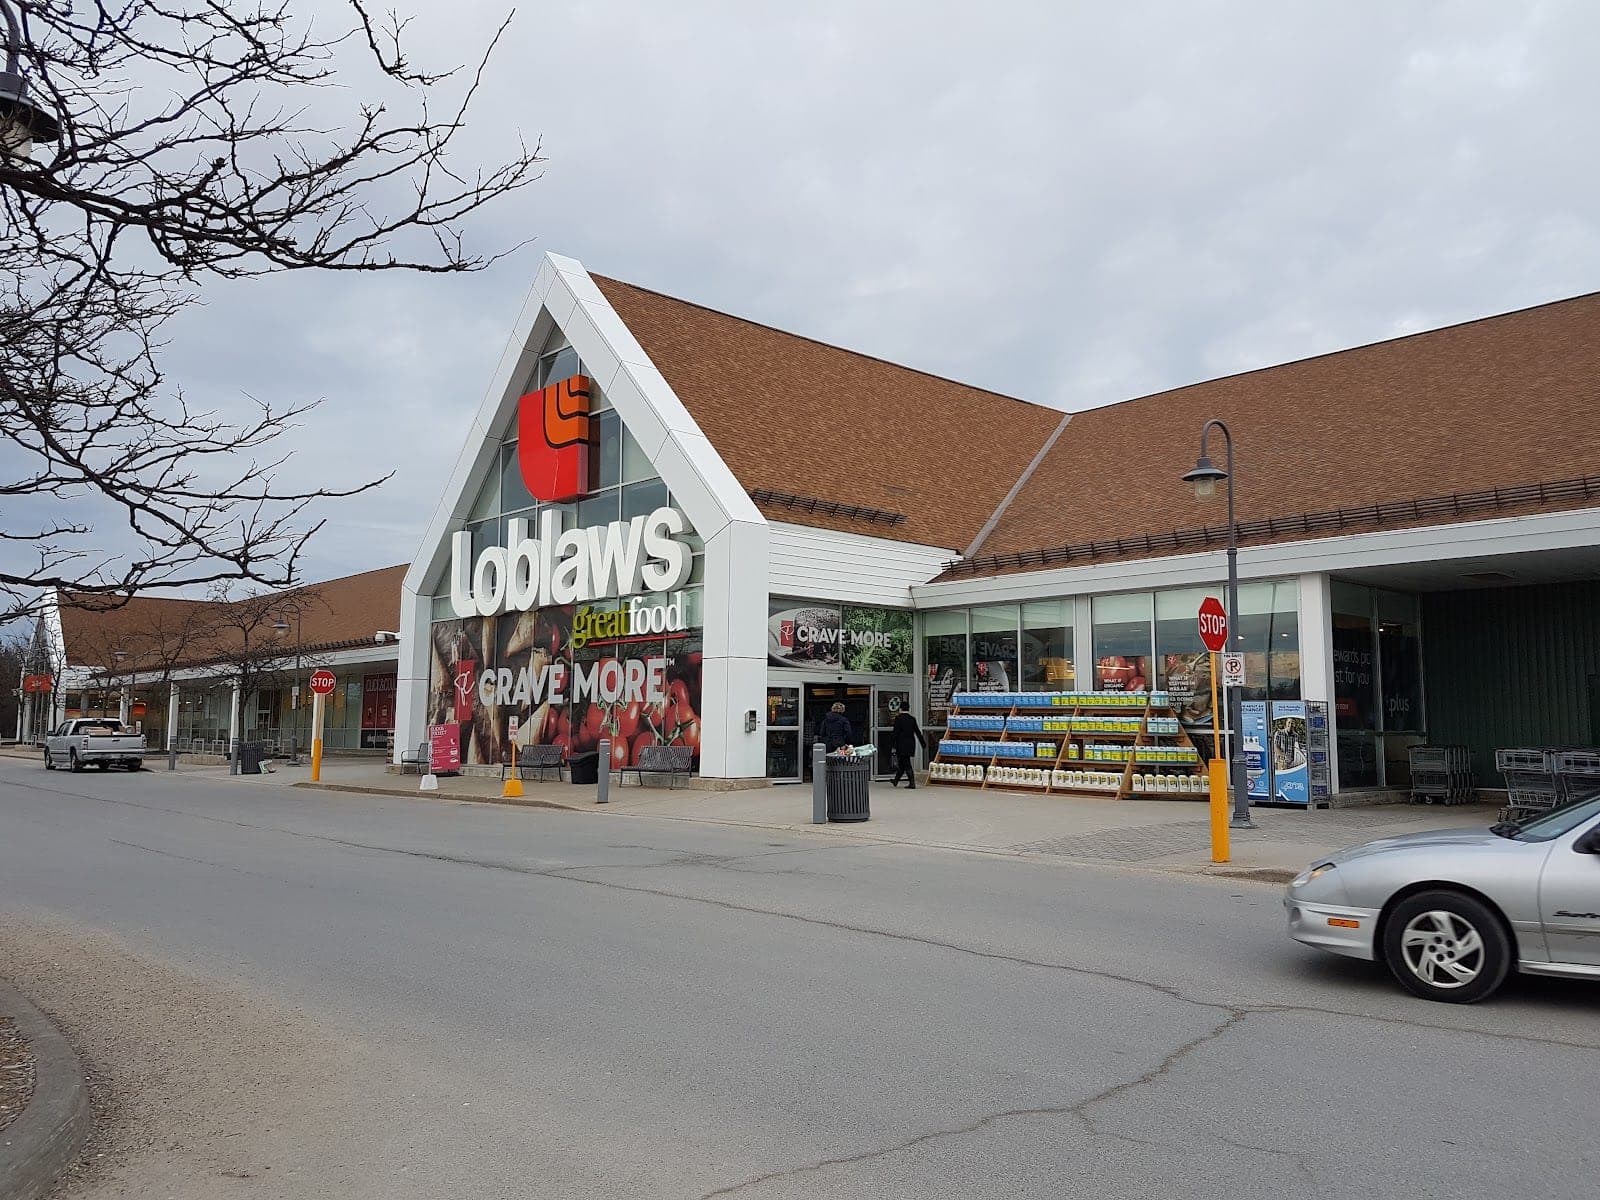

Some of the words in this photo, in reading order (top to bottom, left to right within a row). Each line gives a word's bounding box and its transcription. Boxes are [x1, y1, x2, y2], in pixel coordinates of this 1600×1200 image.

[451, 506, 693, 617] Loblaws
[572, 602, 630, 649] great
[629, 591, 686, 635] food
[1200, 612, 1226, 636] STOP
[796, 625, 846, 645] CRAVE
[850, 630, 892, 647] MORE
[311, 677, 335, 688] STOP
[479, 664, 564, 706] CRAVE
[573, 658, 666, 703] MORE
[1389, 692, 1410, 718] plus
